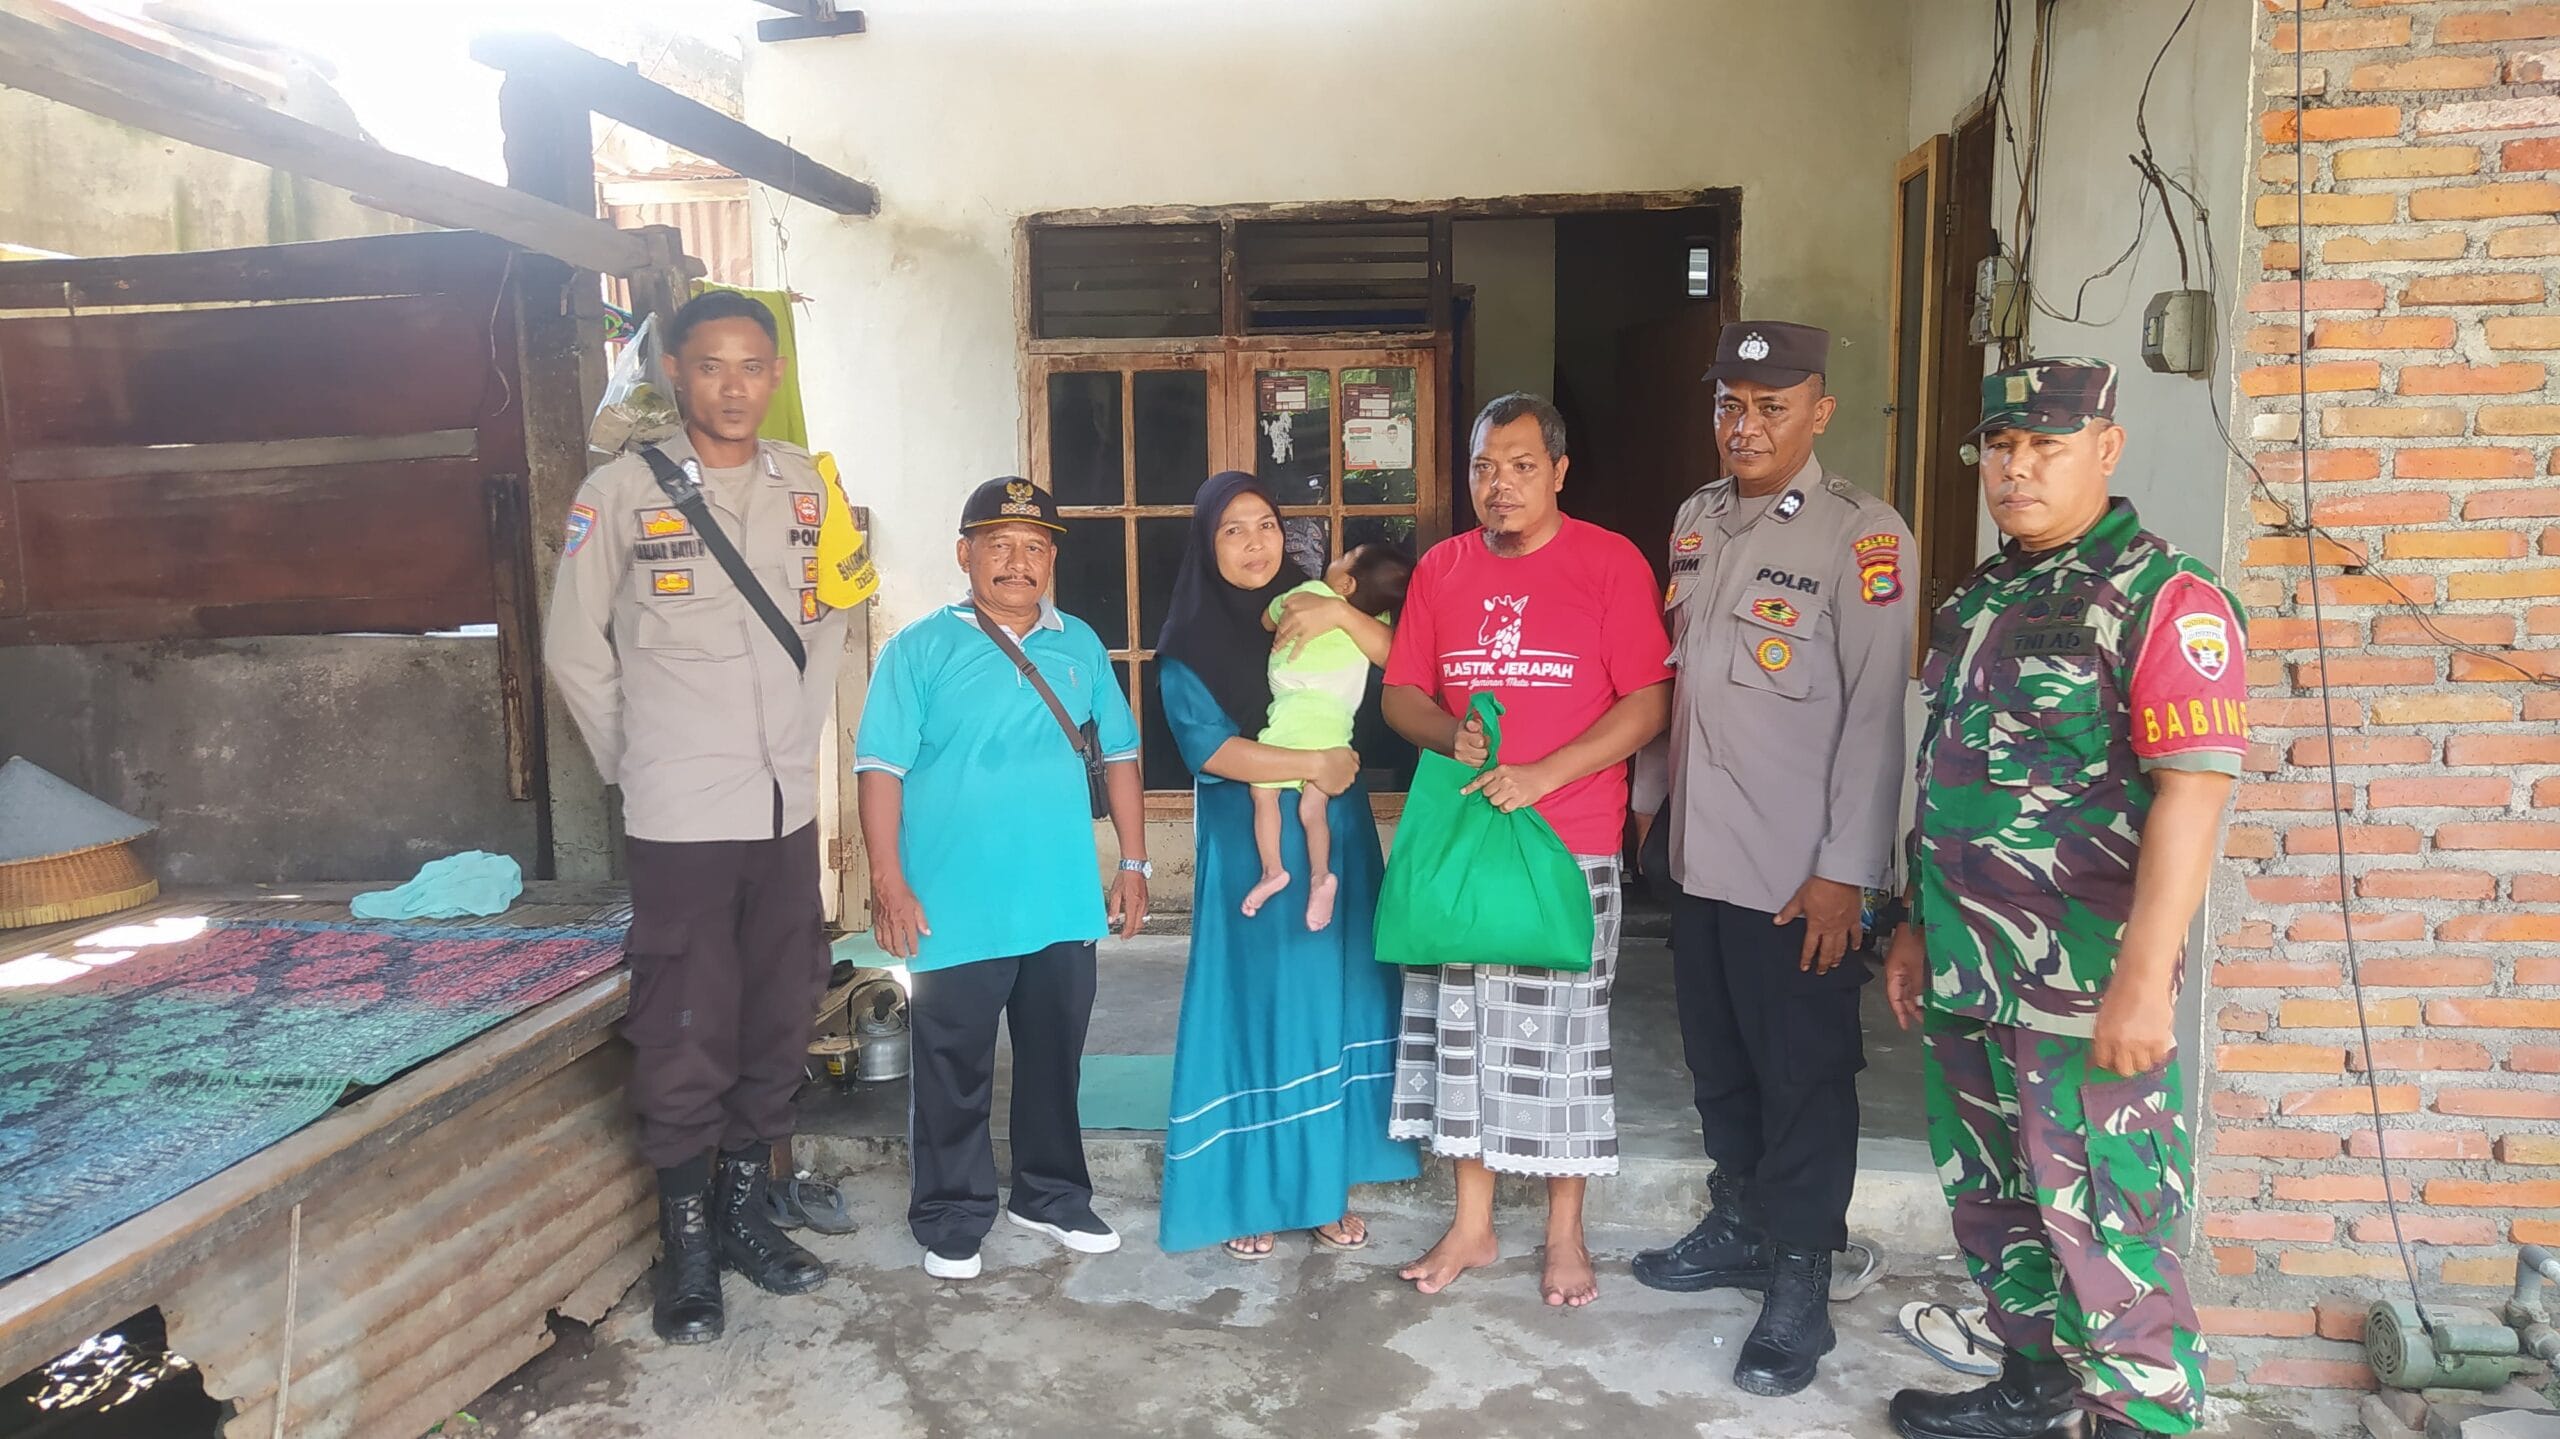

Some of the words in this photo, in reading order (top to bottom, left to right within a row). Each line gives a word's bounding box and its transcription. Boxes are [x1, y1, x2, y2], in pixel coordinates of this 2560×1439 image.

[1756, 567, 1820, 595] POLRI
[2015, 633, 2045, 650] TNI
[2050, 632, 2080, 649] AD
[1442, 661, 1496, 678] PLASTIK
[1498, 661, 1574, 679] JERAPAH
